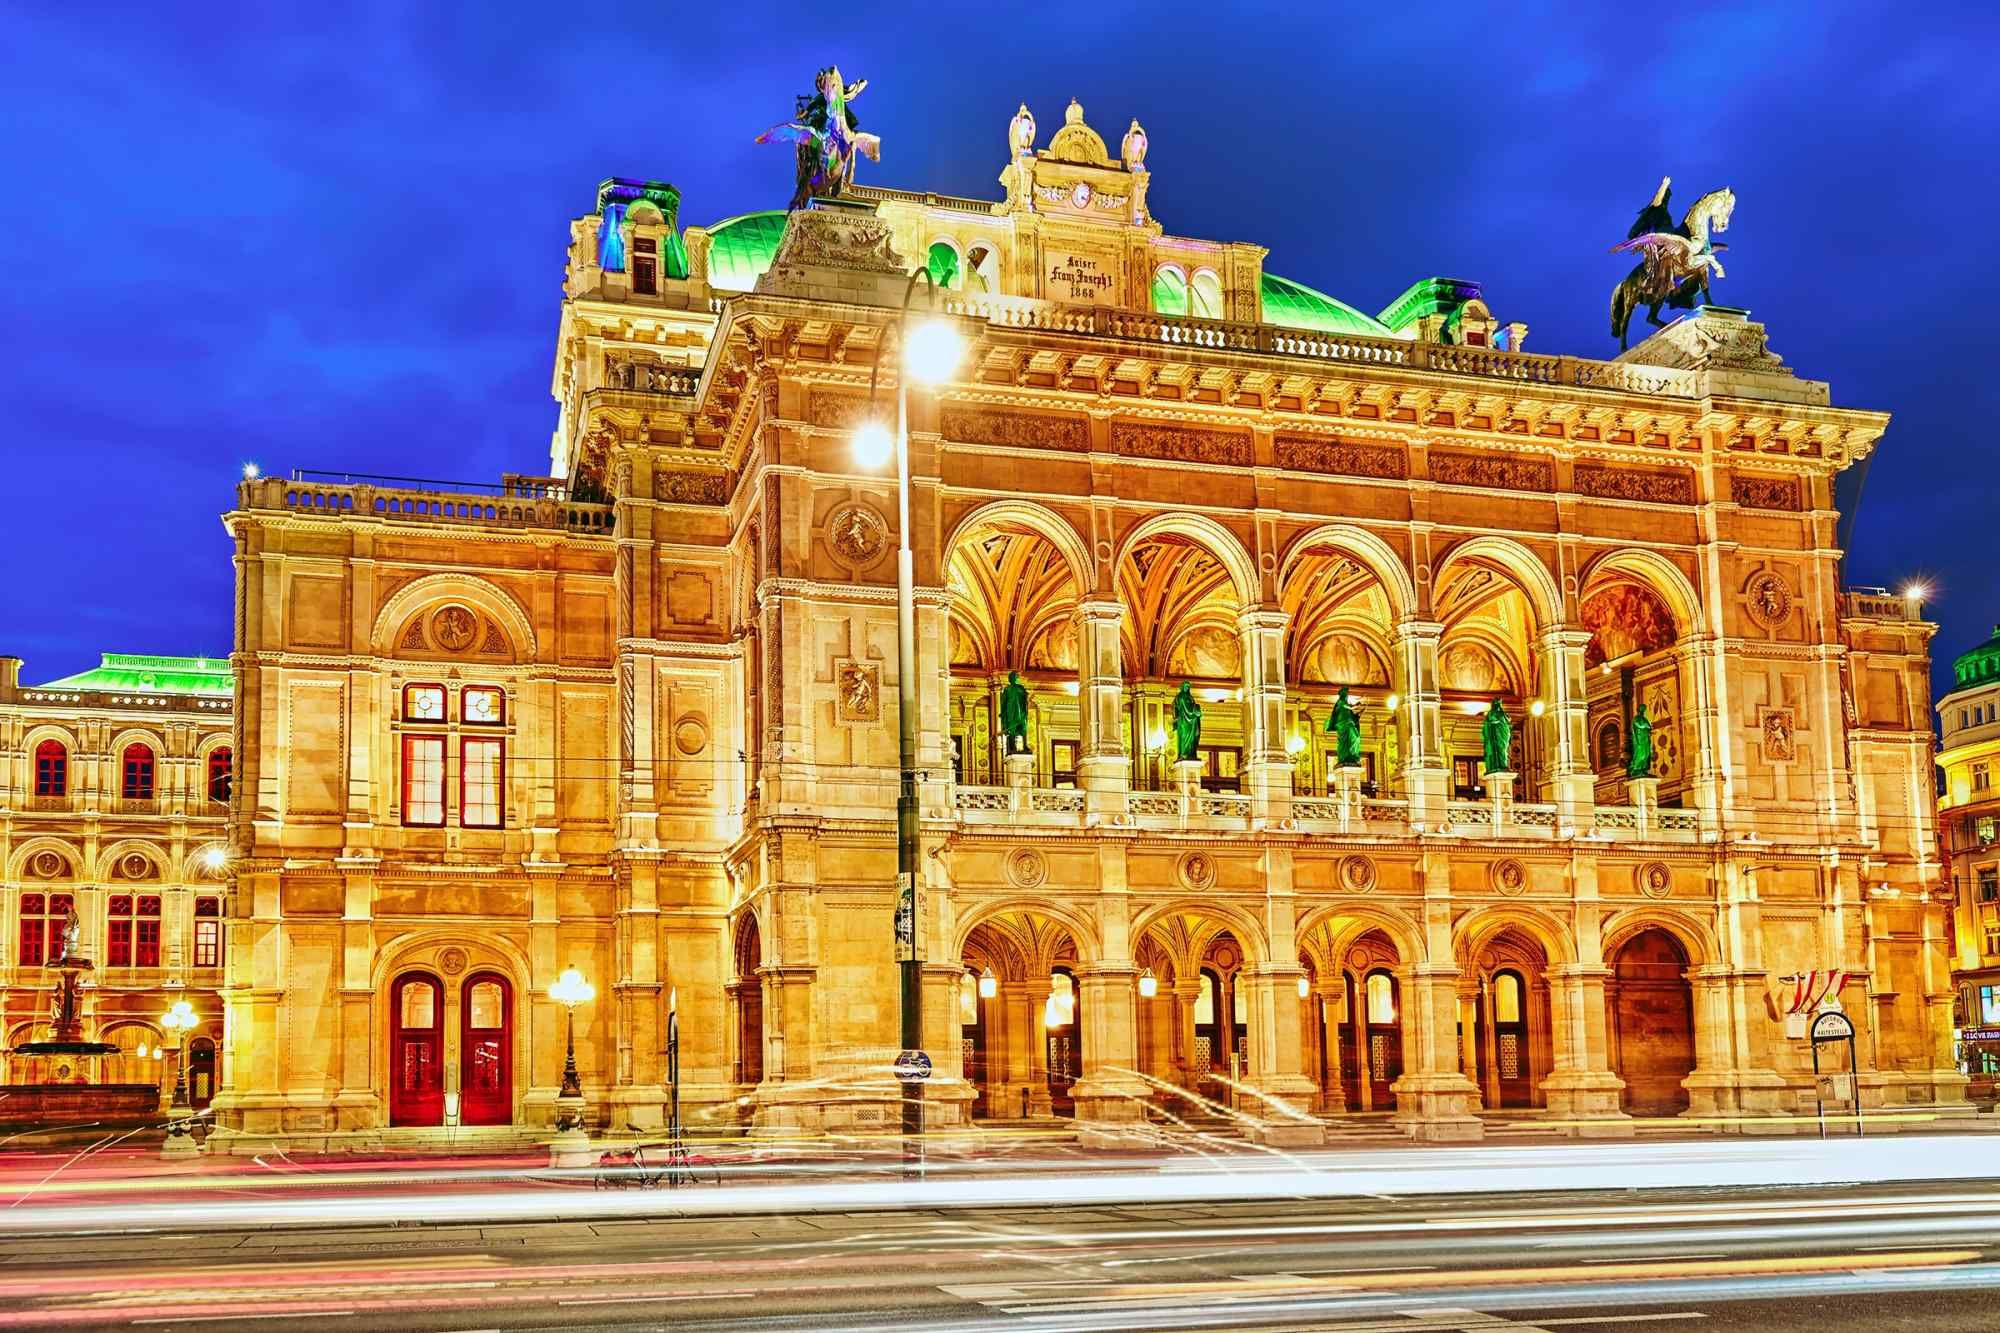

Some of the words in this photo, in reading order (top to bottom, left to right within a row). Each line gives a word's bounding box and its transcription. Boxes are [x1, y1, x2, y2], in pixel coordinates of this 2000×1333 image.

[1067, 256, 1096, 269] Kaiser
[1050, 266, 1075, 286] Franz
[1076, 268, 1106, 290] Joseph
[1070, 287, 1095, 298] 1868
